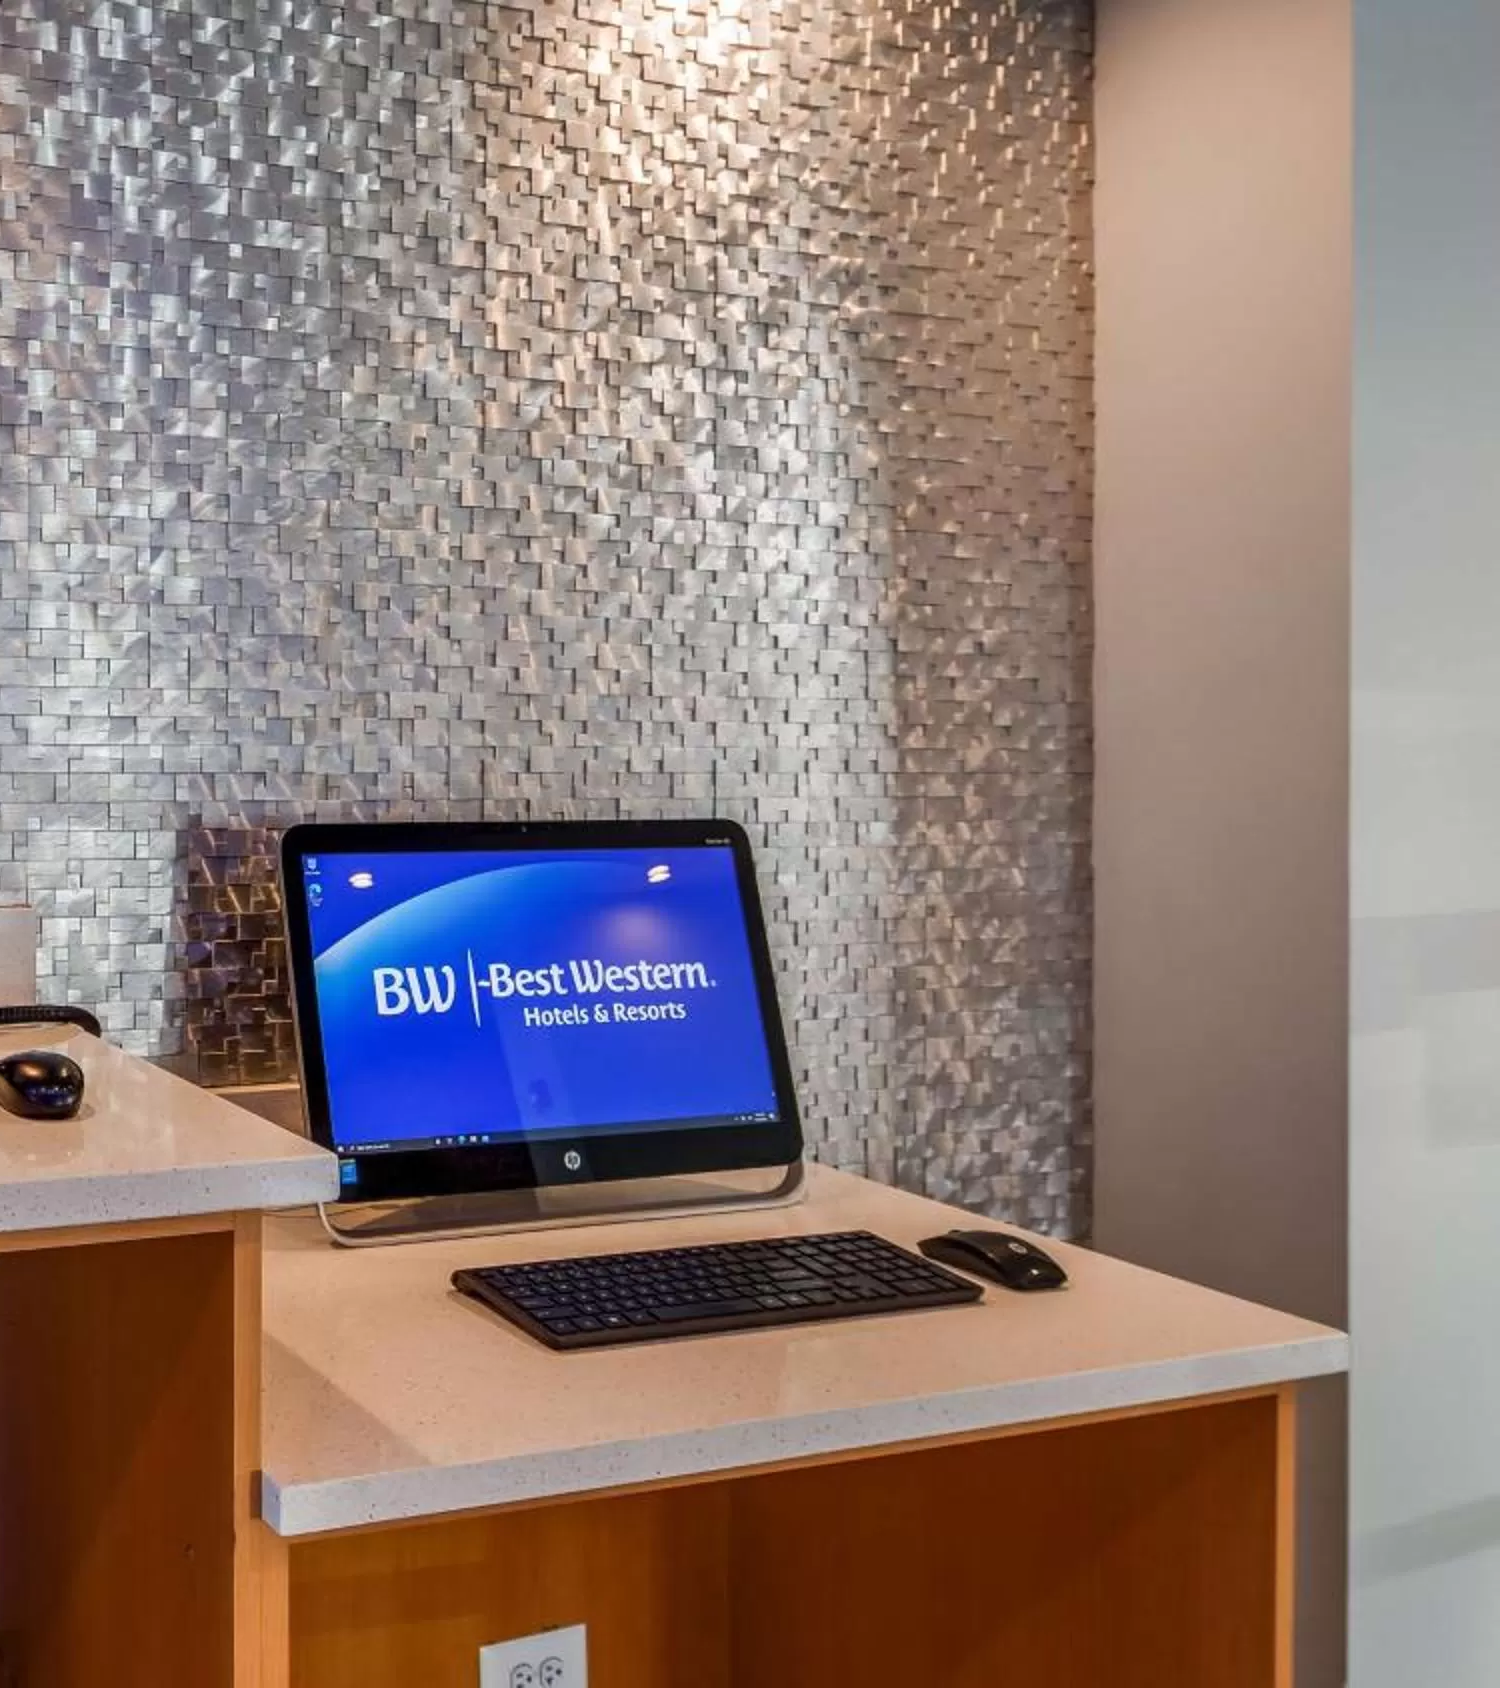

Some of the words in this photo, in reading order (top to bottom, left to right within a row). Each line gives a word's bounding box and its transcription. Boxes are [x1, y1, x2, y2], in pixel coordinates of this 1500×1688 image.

[373, 965, 455, 1015] BW
[489, 962, 568, 997] Best
[569, 959, 709, 993] Western
[523, 1004, 589, 1027] Hotels
[594, 1003, 610, 1023] &
[613, 1001, 686, 1022] Resorts
